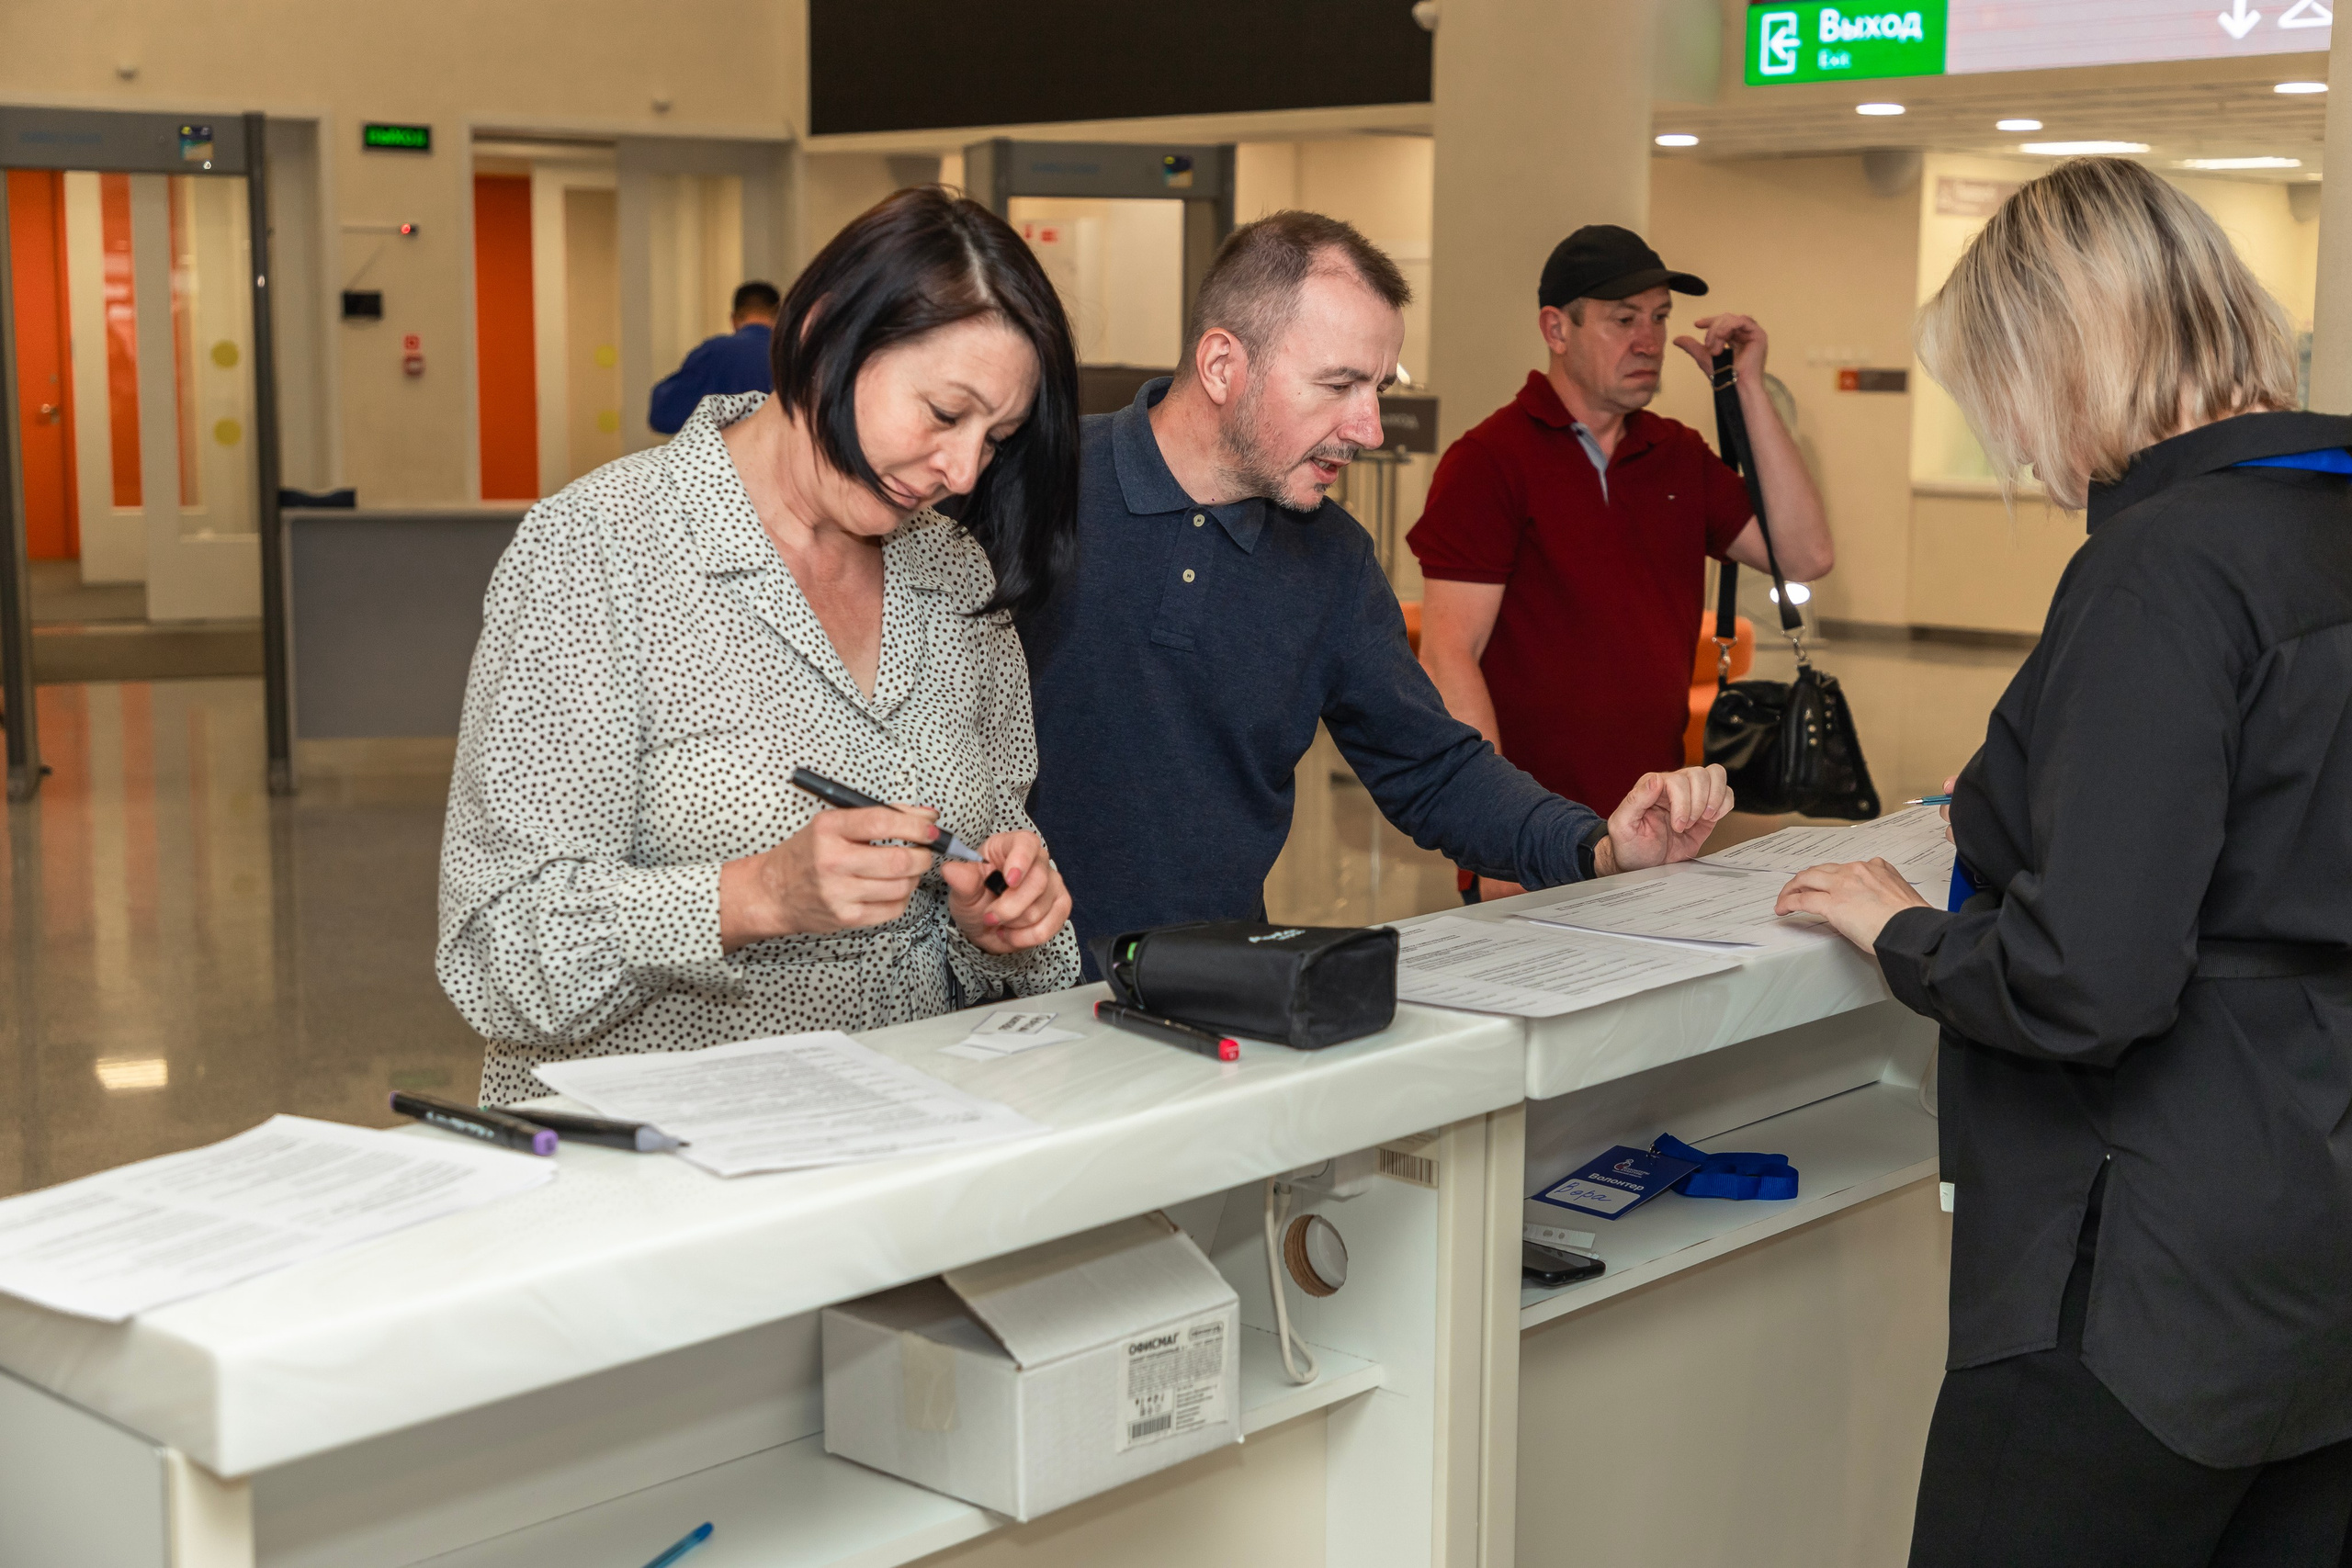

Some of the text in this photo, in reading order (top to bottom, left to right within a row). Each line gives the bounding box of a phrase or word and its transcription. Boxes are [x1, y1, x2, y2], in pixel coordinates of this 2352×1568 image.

[1819, 7, 1924, 43] Выход
[1588, 1172, 1645, 1191] Волонтер
[1129, 1332, 1180, 1356] ОФИСМАГ
